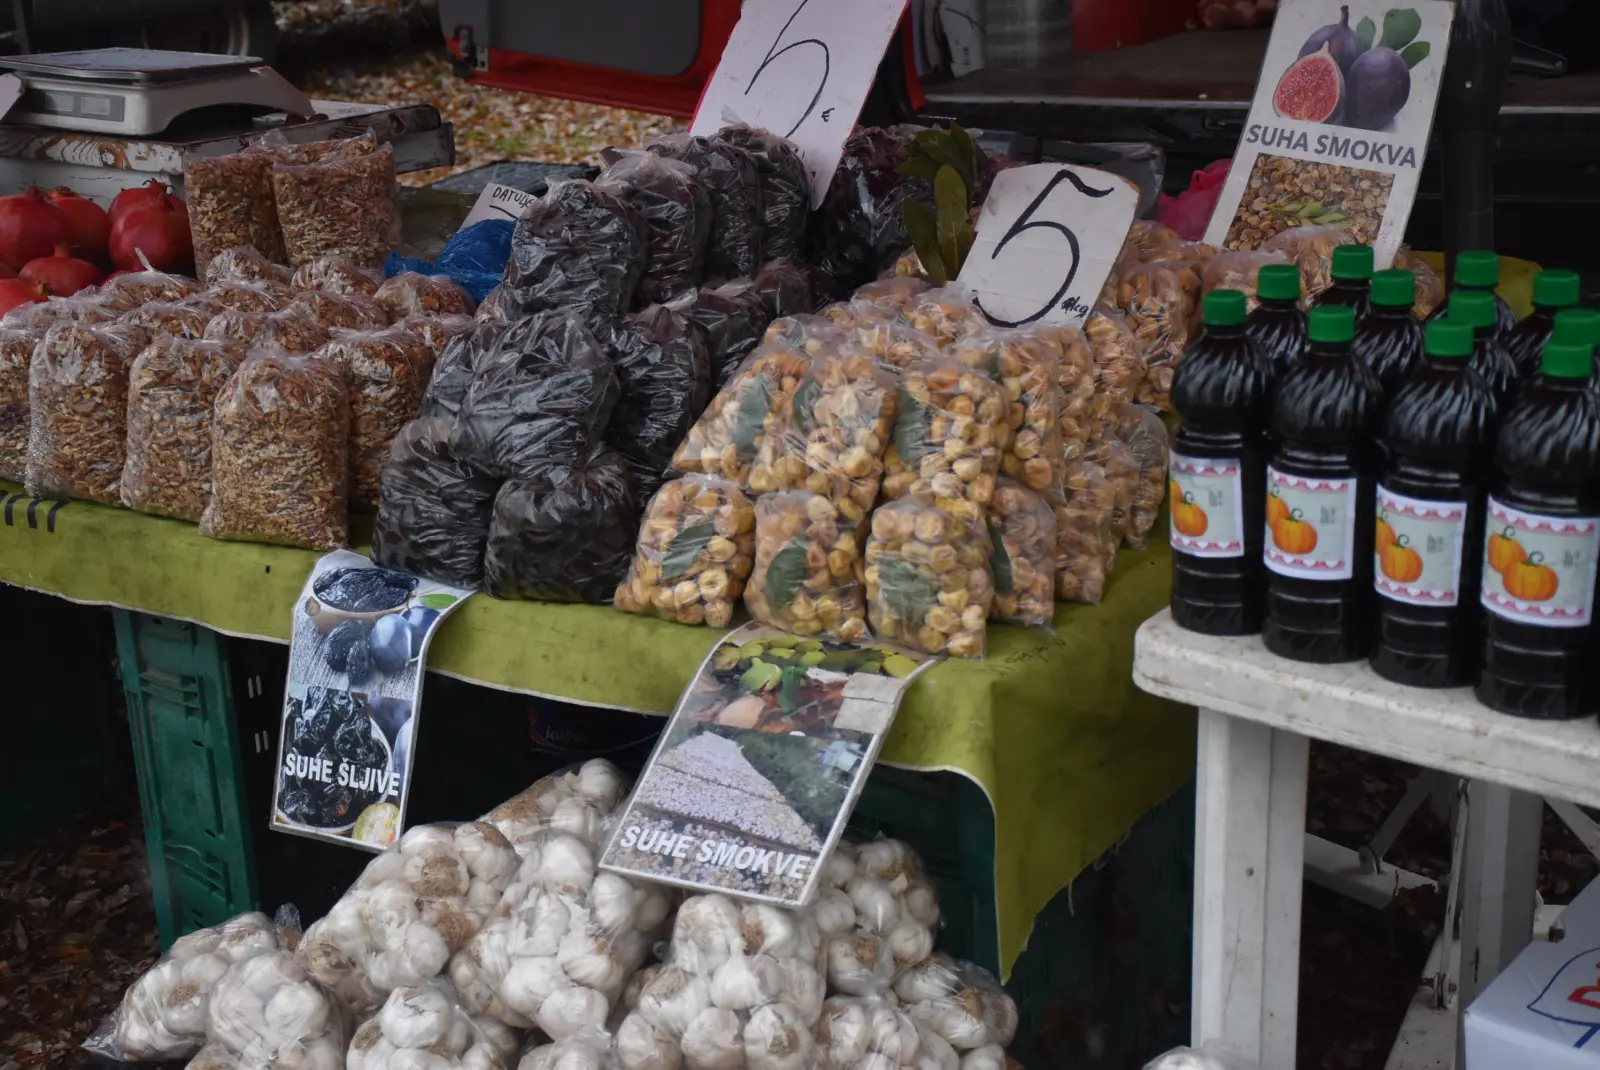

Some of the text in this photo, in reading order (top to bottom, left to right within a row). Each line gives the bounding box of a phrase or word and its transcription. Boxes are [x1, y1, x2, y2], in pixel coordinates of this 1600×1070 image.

[1246, 123, 1417, 168] SUHA SMOKVA
[972, 169, 1115, 328] 5
[284, 753, 400, 796] SUHE ŠLJIVE
[620, 826, 811, 879] SUHE SMOKVE
